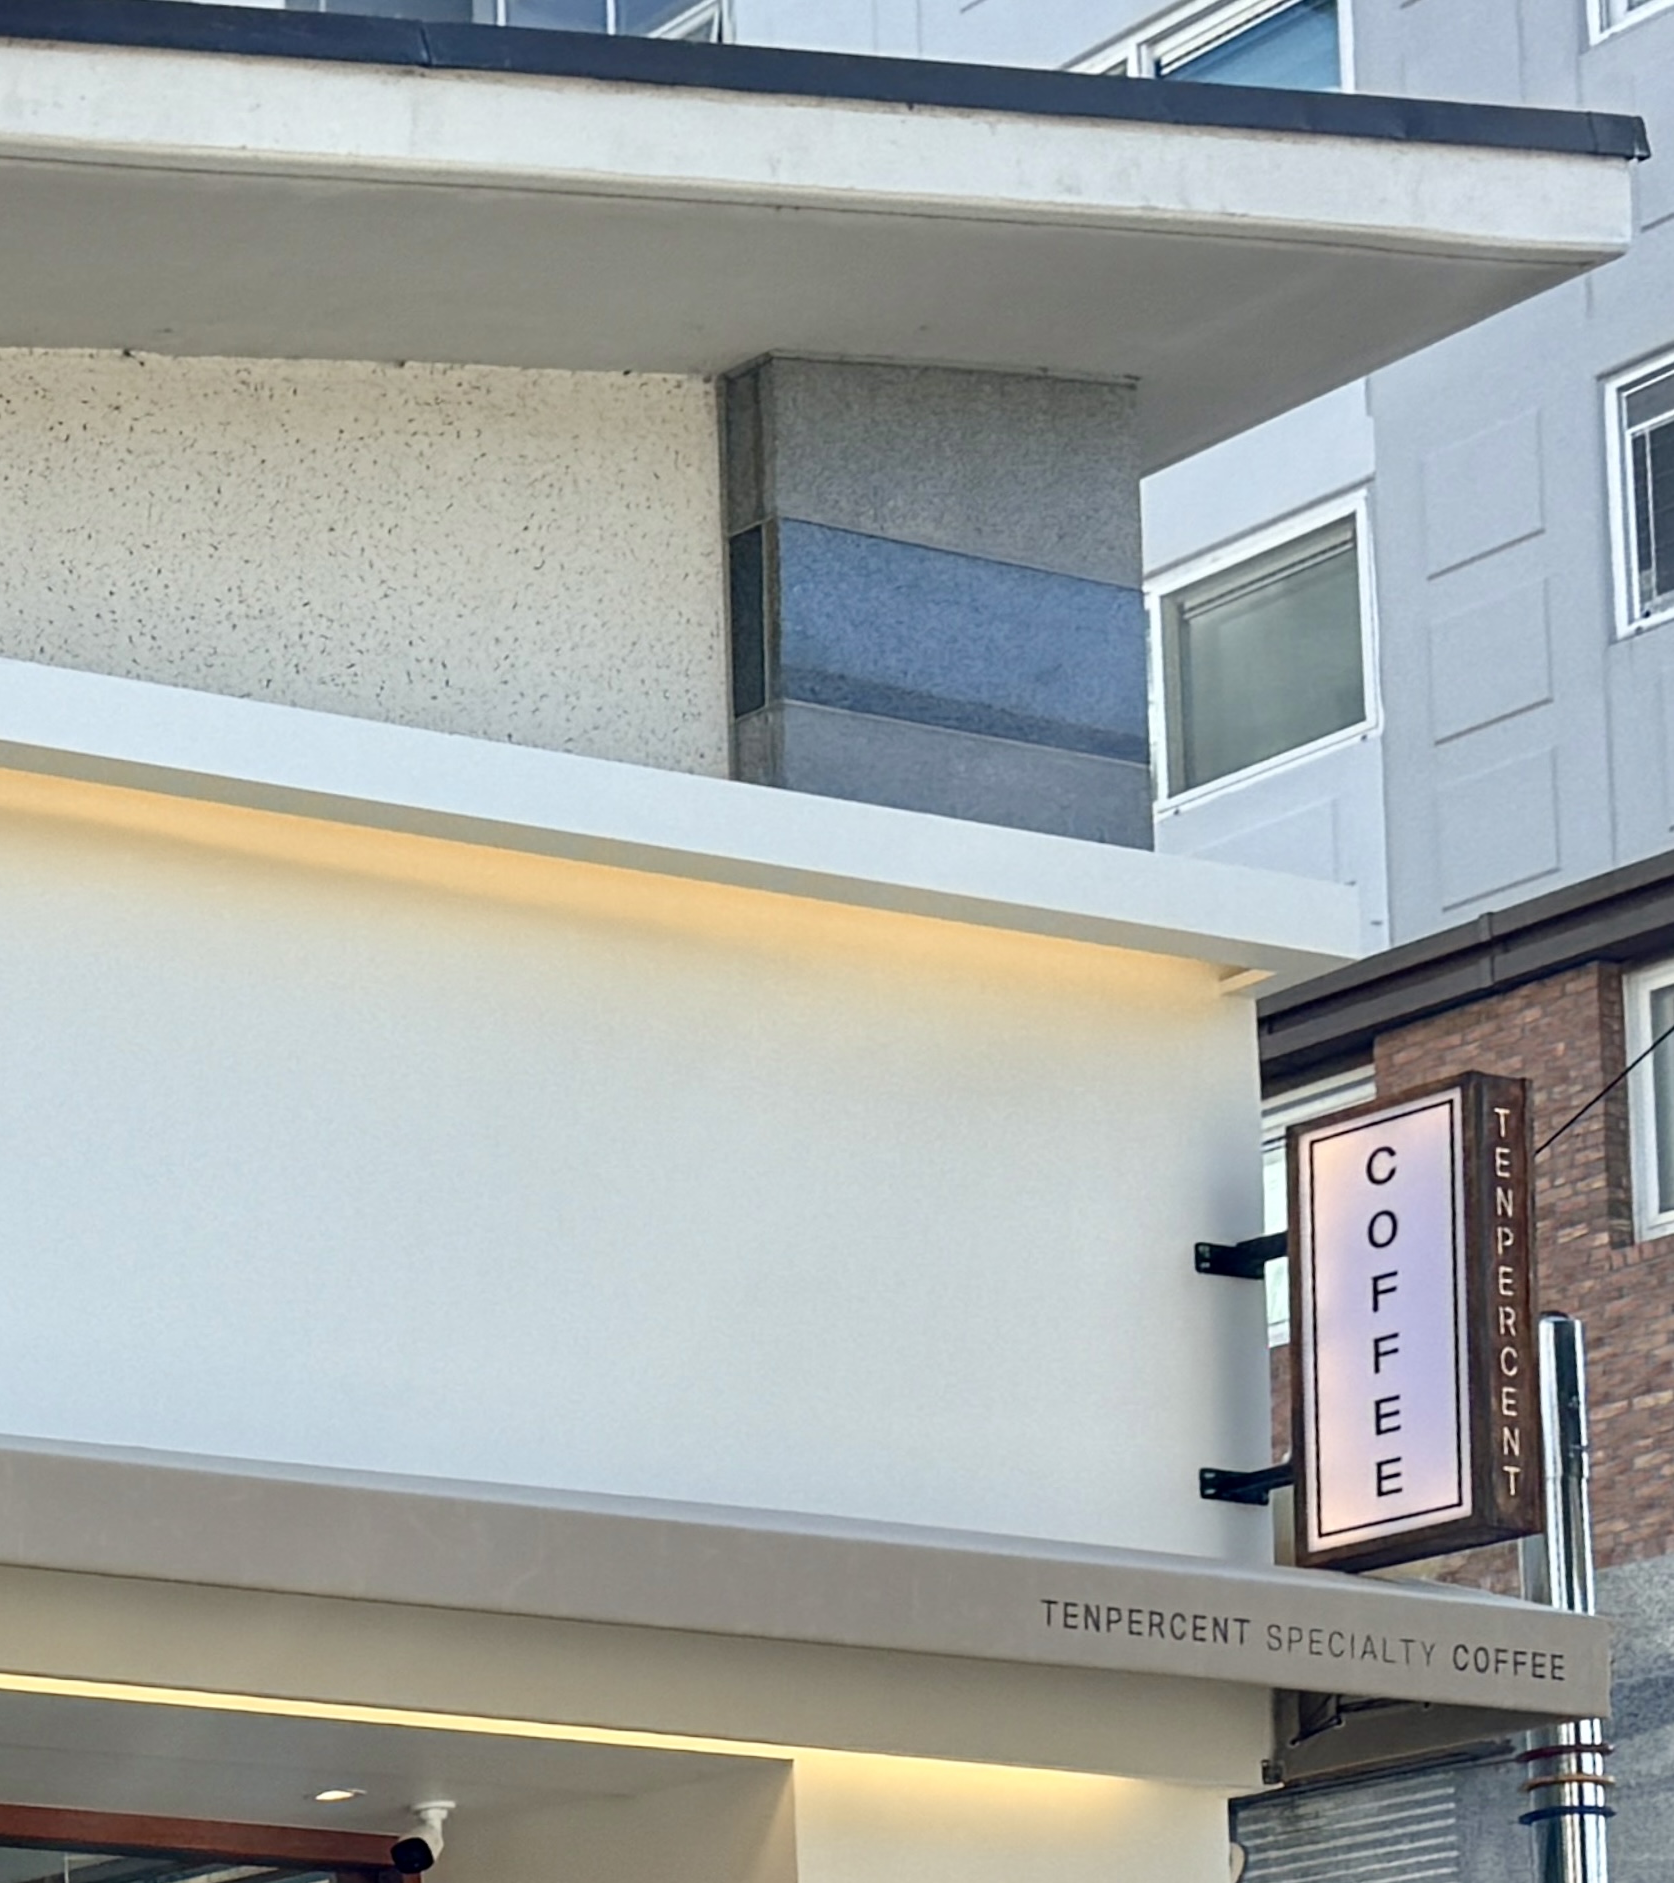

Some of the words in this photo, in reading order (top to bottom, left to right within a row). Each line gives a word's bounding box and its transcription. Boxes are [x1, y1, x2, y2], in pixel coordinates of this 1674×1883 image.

[1365, 1146, 1403, 1497] COFFEE
[1493, 1106, 1521, 1497] TENPERCENT
[1041, 1599, 1251, 1647] TENPERCENT
[1266, 1623, 1438, 1668] SPECIALTY
[1453, 1643, 1566, 1682] COFFEE
